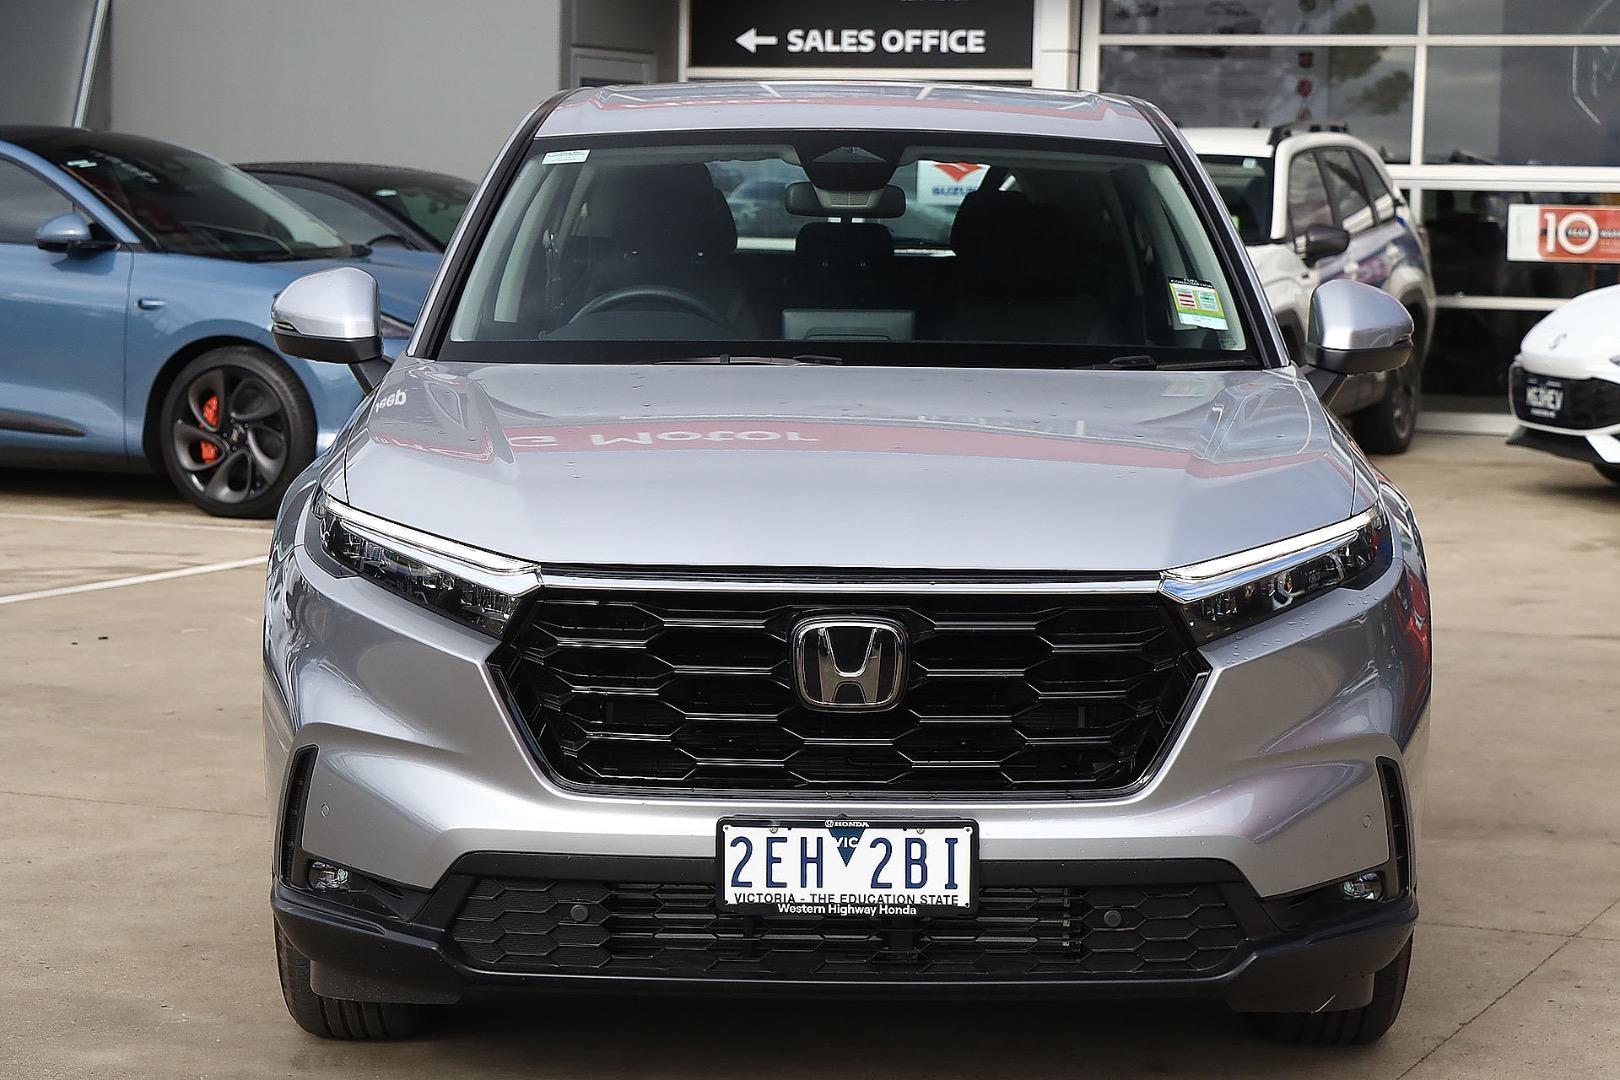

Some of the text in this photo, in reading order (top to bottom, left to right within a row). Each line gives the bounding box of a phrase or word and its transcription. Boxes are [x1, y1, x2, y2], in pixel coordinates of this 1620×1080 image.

[786, 28, 987, 54] SALES OFFICE
[729, 836, 824, 889] 2EH
[732, 893, 795, 903] VICTORIA
[810, 893, 835, 904] THE
[840, 893, 915, 904] EDUCATION
[920, 894, 958, 905] STATE
[777, 903, 917, 917] Western Highway Honda
